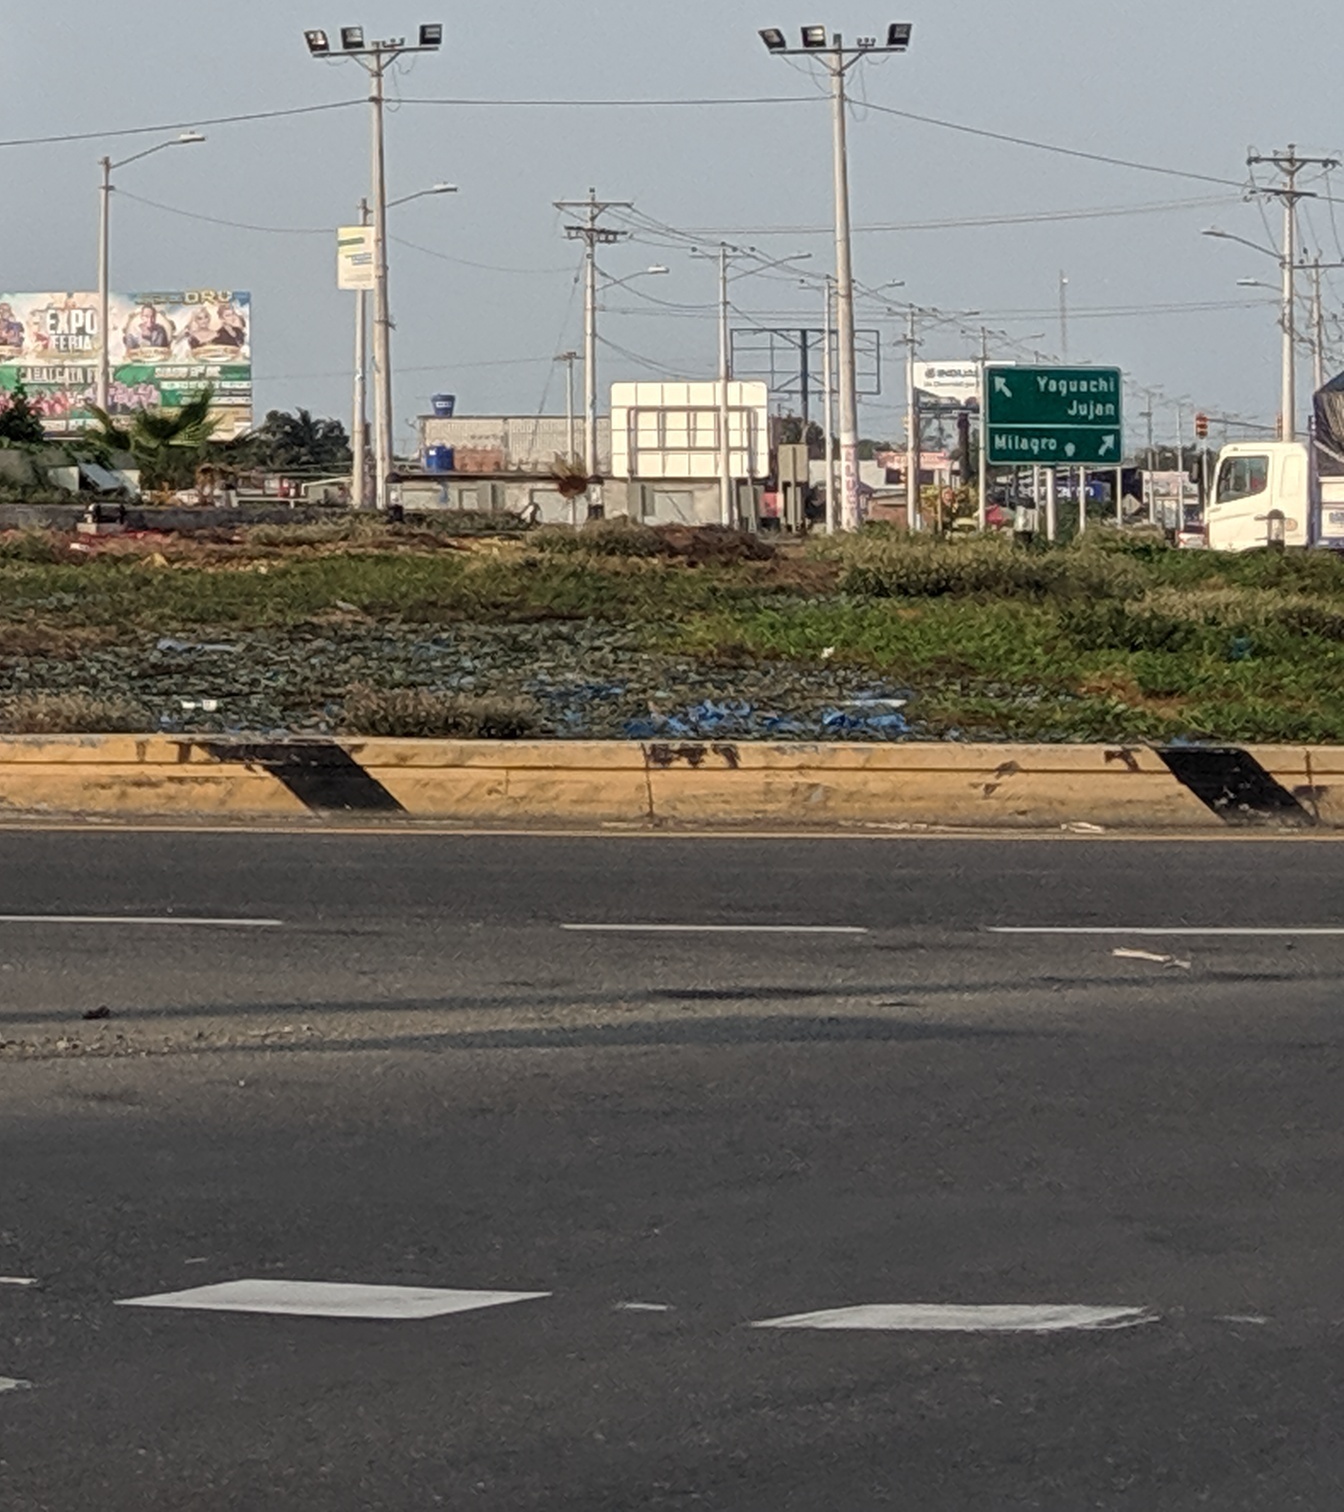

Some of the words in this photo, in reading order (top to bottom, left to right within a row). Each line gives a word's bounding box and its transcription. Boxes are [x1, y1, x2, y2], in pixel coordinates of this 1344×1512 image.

[46, 309, 97, 335] EXPO
[1037, 376, 1115, 397] Yaguachi
[1067, 400, 1115, 420] Jujan
[994, 434, 1058, 455] Milagro
